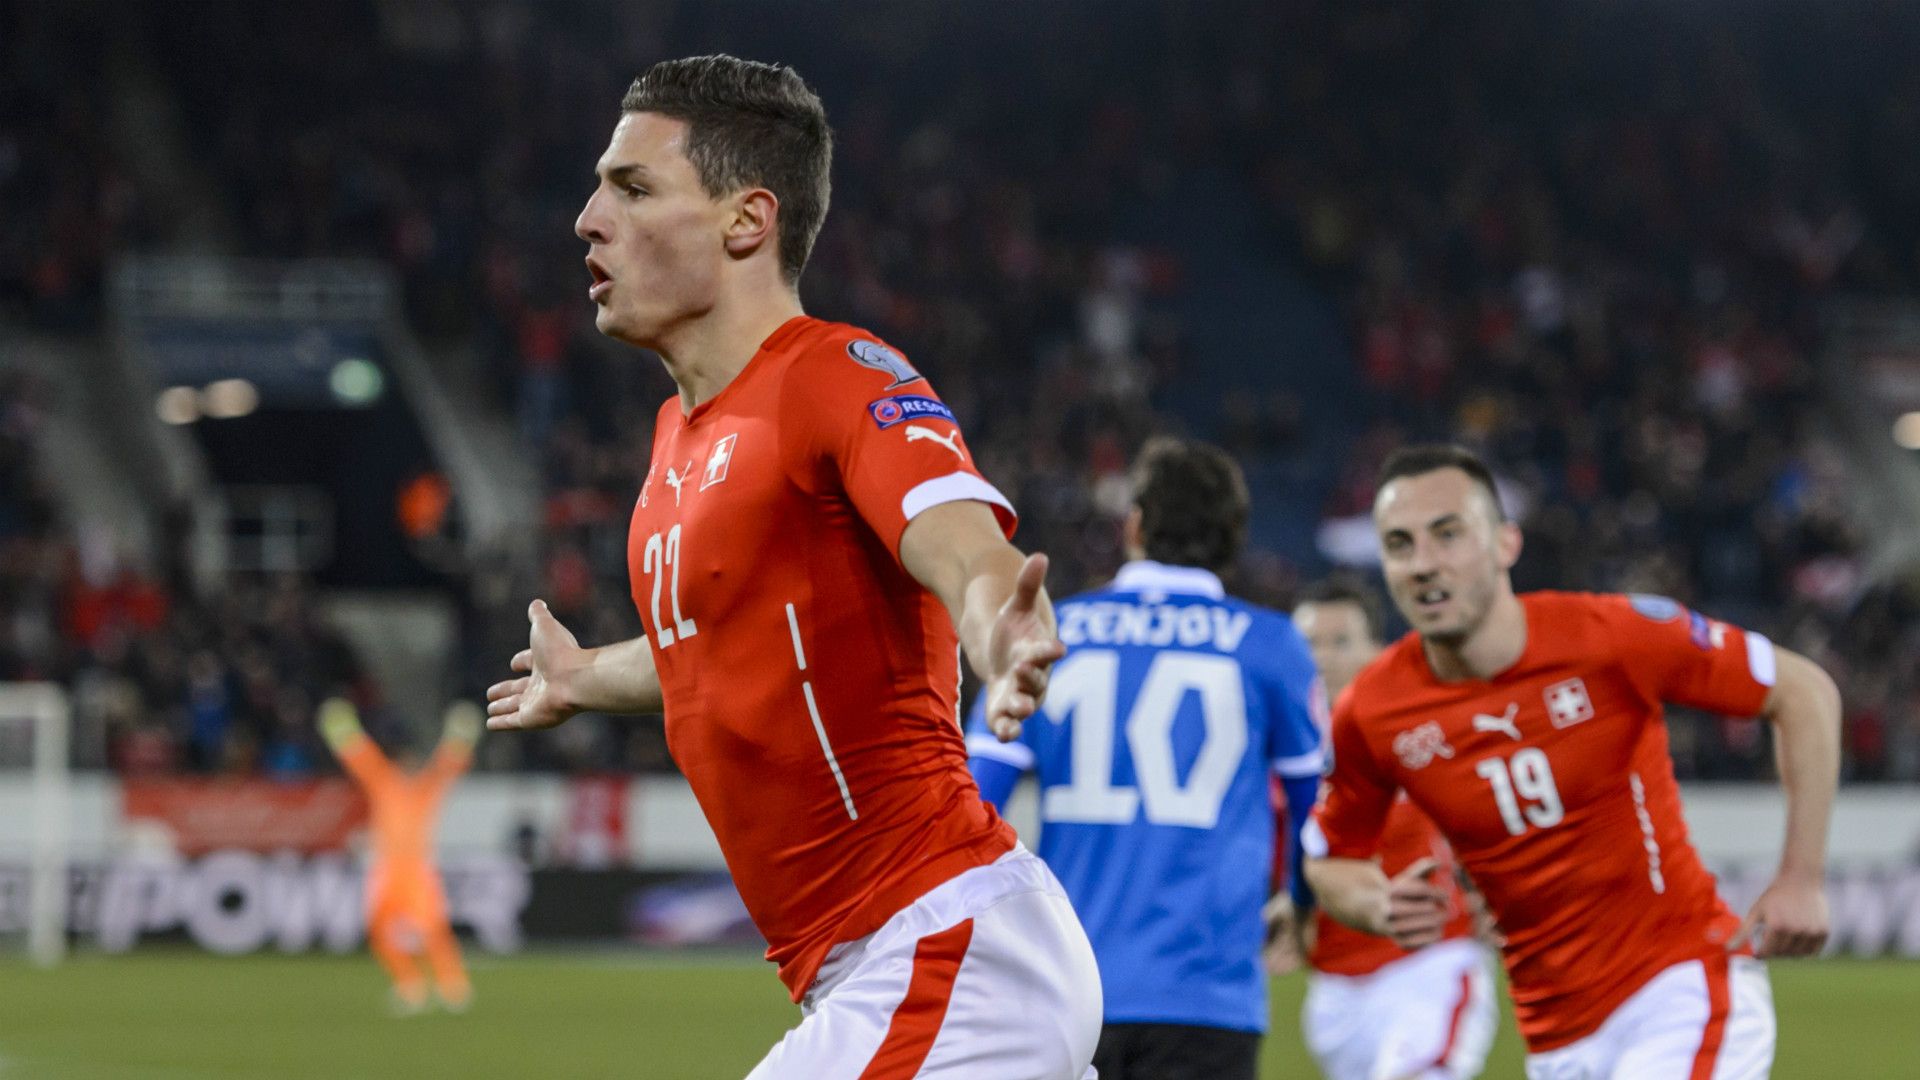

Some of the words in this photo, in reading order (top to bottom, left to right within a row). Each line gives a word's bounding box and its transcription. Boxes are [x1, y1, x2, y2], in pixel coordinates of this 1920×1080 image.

[643, 524, 697, 649] 22
[1058, 602, 1252, 652] ZENJOV
[1042, 649, 1249, 829] 10
[1476, 747, 1566, 836] 19
[98, 850, 530, 955] POWR
